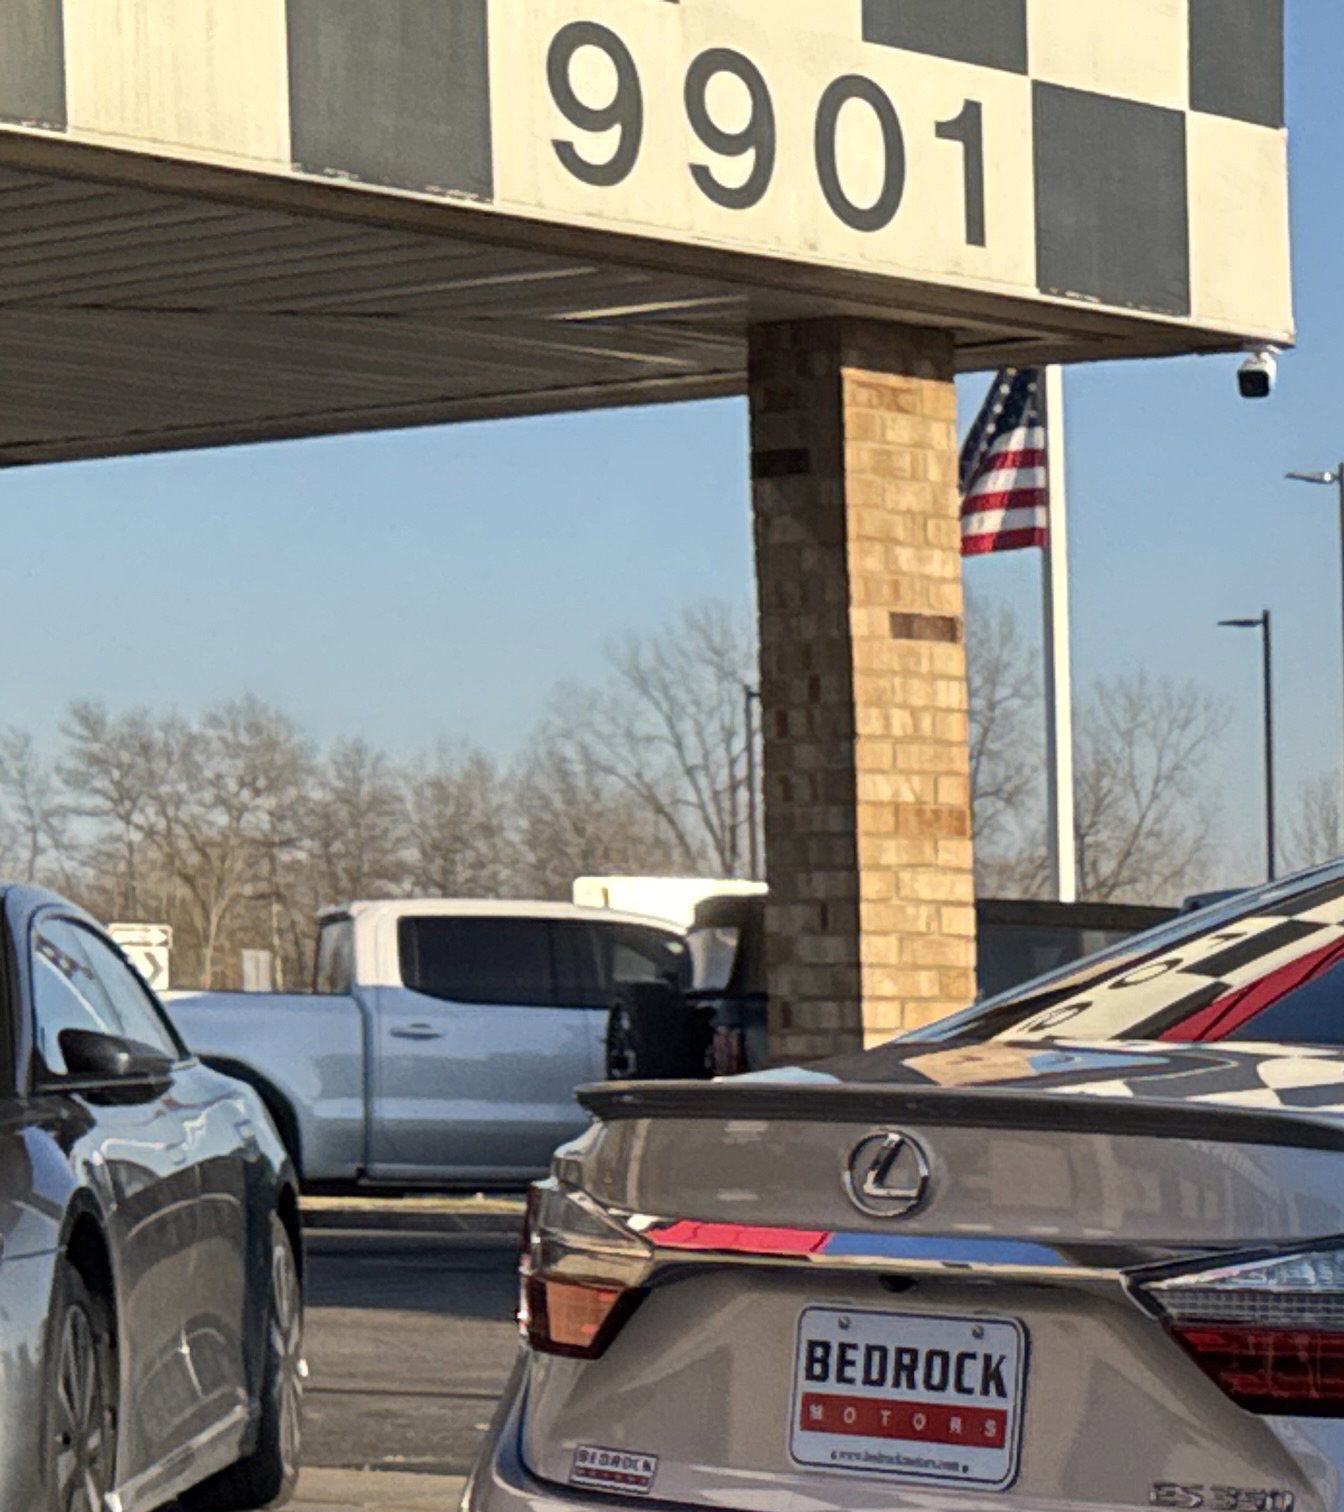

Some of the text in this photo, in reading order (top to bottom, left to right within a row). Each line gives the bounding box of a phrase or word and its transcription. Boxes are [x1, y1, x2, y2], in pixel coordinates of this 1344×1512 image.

[546, 20, 987, 247] 9901
[804, 1338, 1008, 1398] BEDROCK
[808, 1403, 997, 1438] MOTORS
[1150, 1481, 1204, 1509] ES
